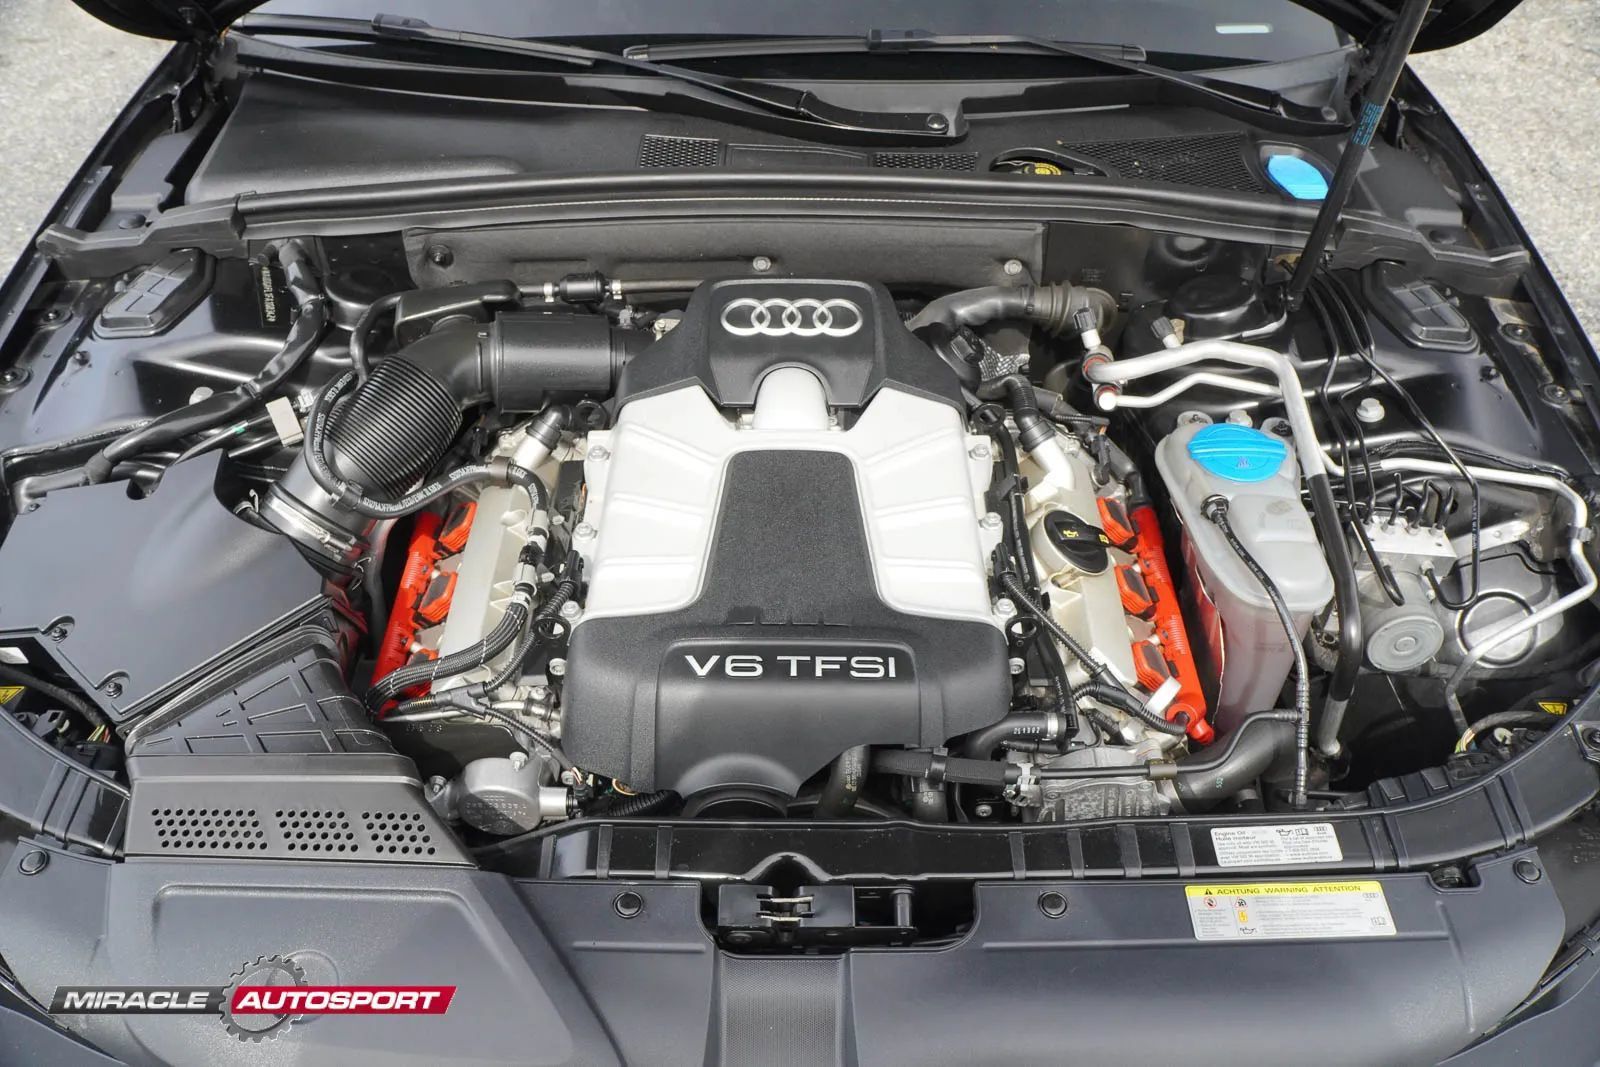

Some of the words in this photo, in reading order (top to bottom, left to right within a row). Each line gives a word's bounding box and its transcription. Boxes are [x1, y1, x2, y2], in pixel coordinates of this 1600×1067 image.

[684, 655, 764, 678] V6
[776, 655, 897, 678] TFSI
[1312, 885, 1361, 893] ATTENTION
